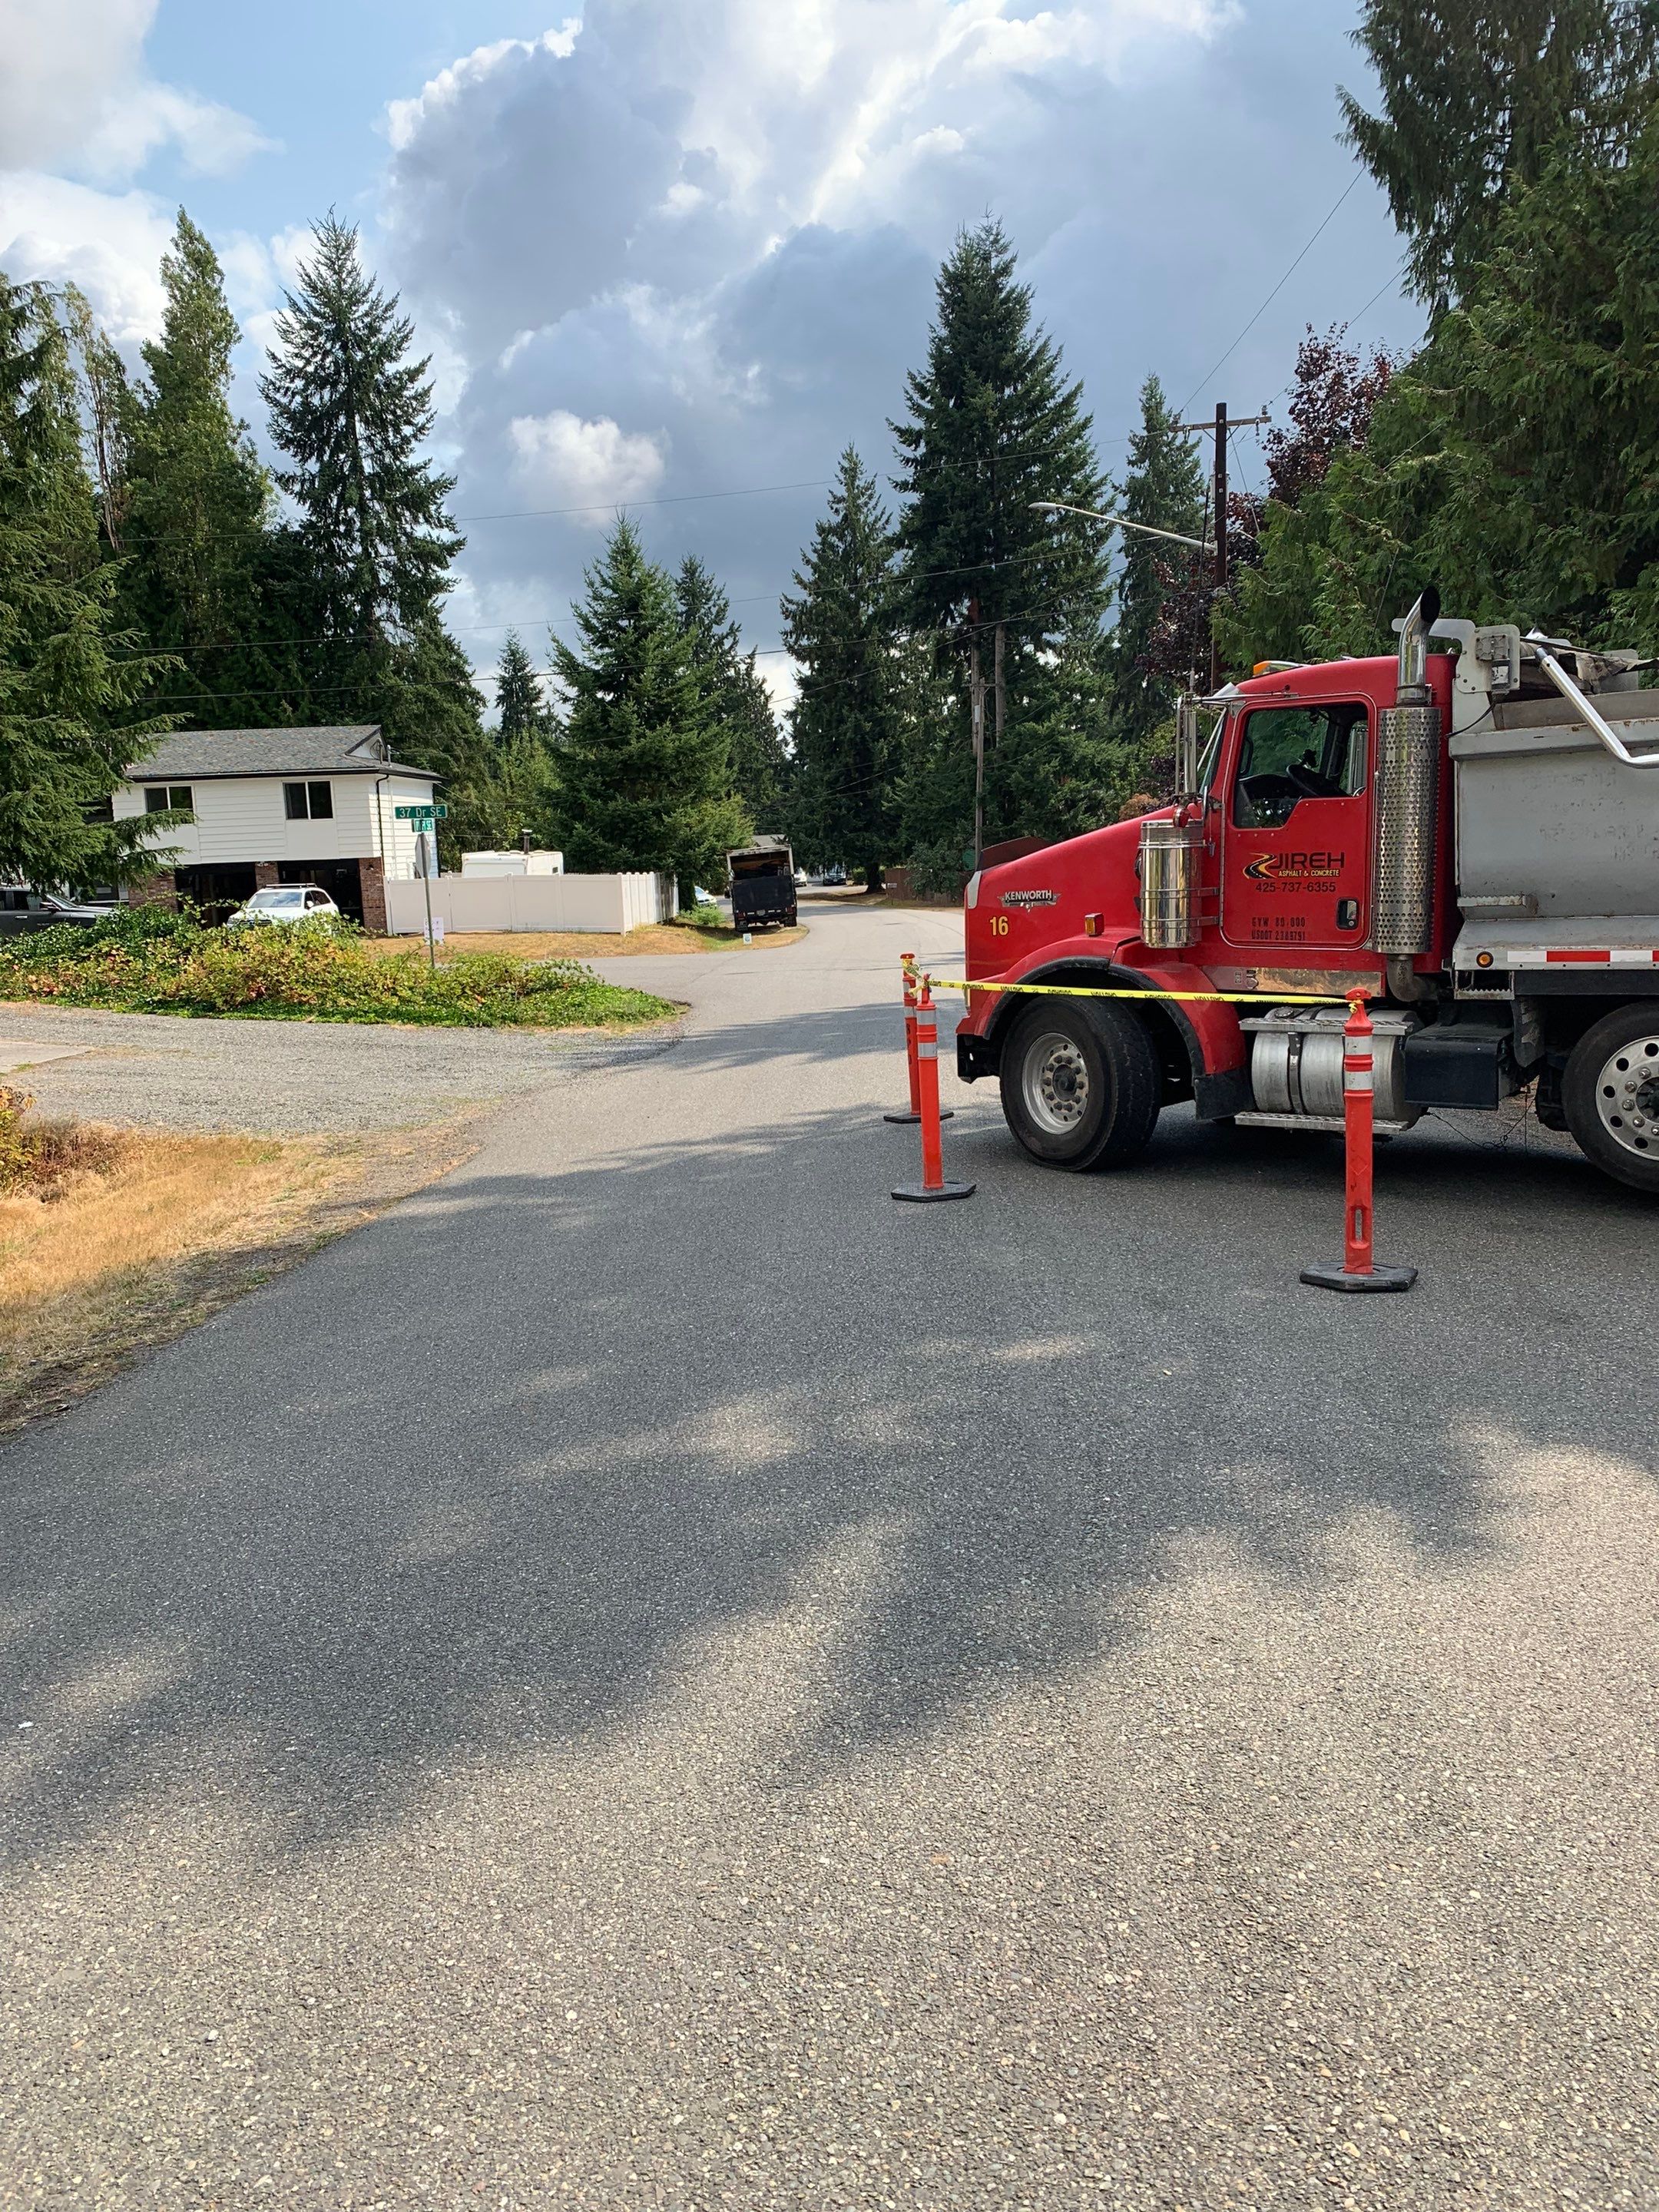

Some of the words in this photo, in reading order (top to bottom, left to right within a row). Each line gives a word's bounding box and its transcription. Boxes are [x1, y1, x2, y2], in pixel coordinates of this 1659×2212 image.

[399, 807, 412, 818] 37
[416, 807, 426, 818] Dr
[430, 806, 442, 817] SE
[1269, 852, 1344, 869] JIREH
[1310, 869, 1339, 877] CONCRETE
[1255, 882, 1336, 892] 425-737-6355
[1005, 889, 1052, 901] KENWORTH
[989, 916, 1009, 936] 16
[1251, 929, 1273, 940] USDOT
